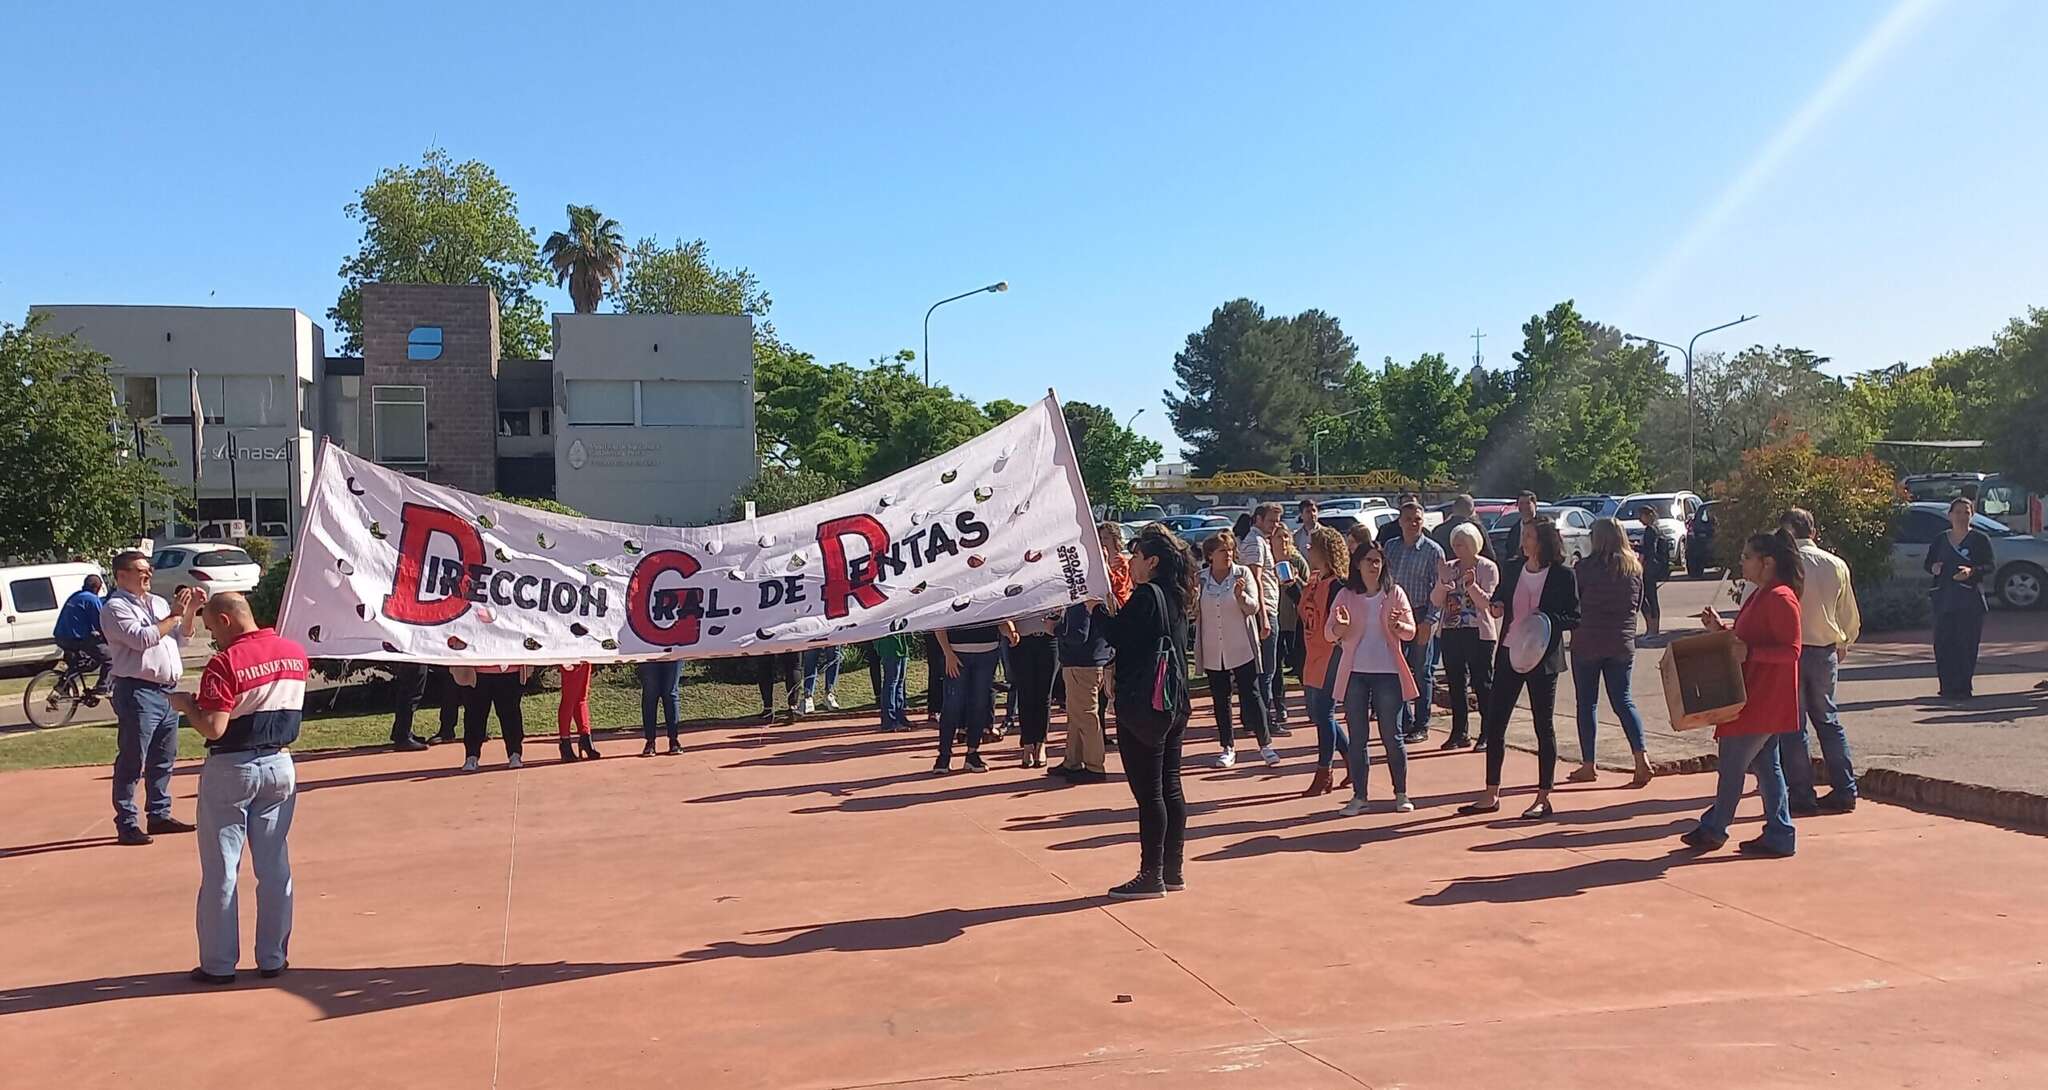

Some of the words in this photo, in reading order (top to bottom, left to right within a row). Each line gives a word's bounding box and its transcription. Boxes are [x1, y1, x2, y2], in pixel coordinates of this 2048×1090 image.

[382, 502, 608, 626] DIRECCION
[626, 549, 742, 646] GRAL.
[758, 575, 806, 609] DE
[816, 511, 990, 620] RENTAS
[1066, 546, 1089, 595] 15617026
[237, 658, 304, 683] PARISIENNES
